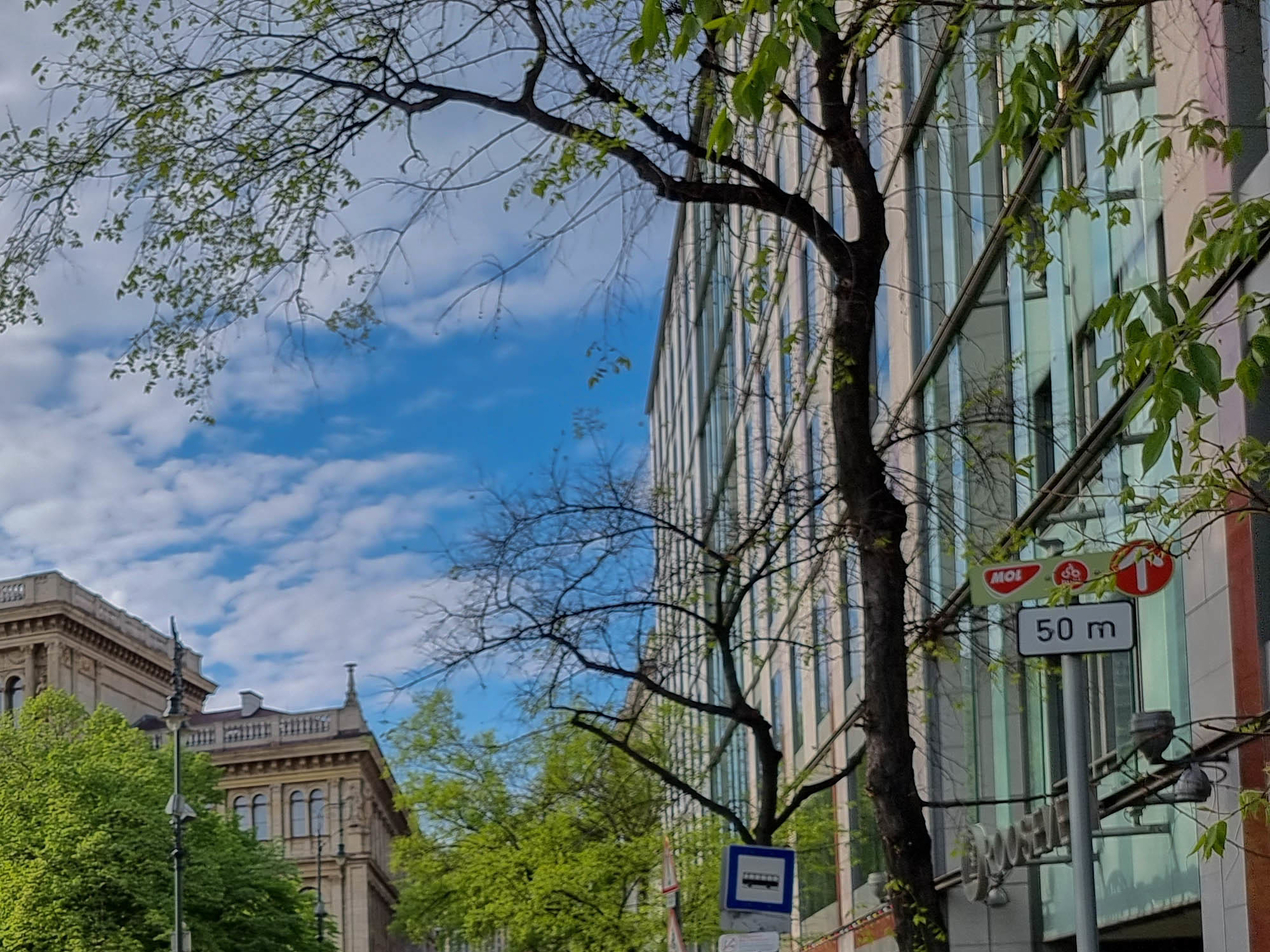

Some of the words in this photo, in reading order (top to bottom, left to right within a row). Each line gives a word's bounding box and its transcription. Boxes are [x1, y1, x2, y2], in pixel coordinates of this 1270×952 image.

[990, 569, 1023, 584] MOL
[1036, 616, 1073, 643] 50
[1087, 619, 1116, 640] m
